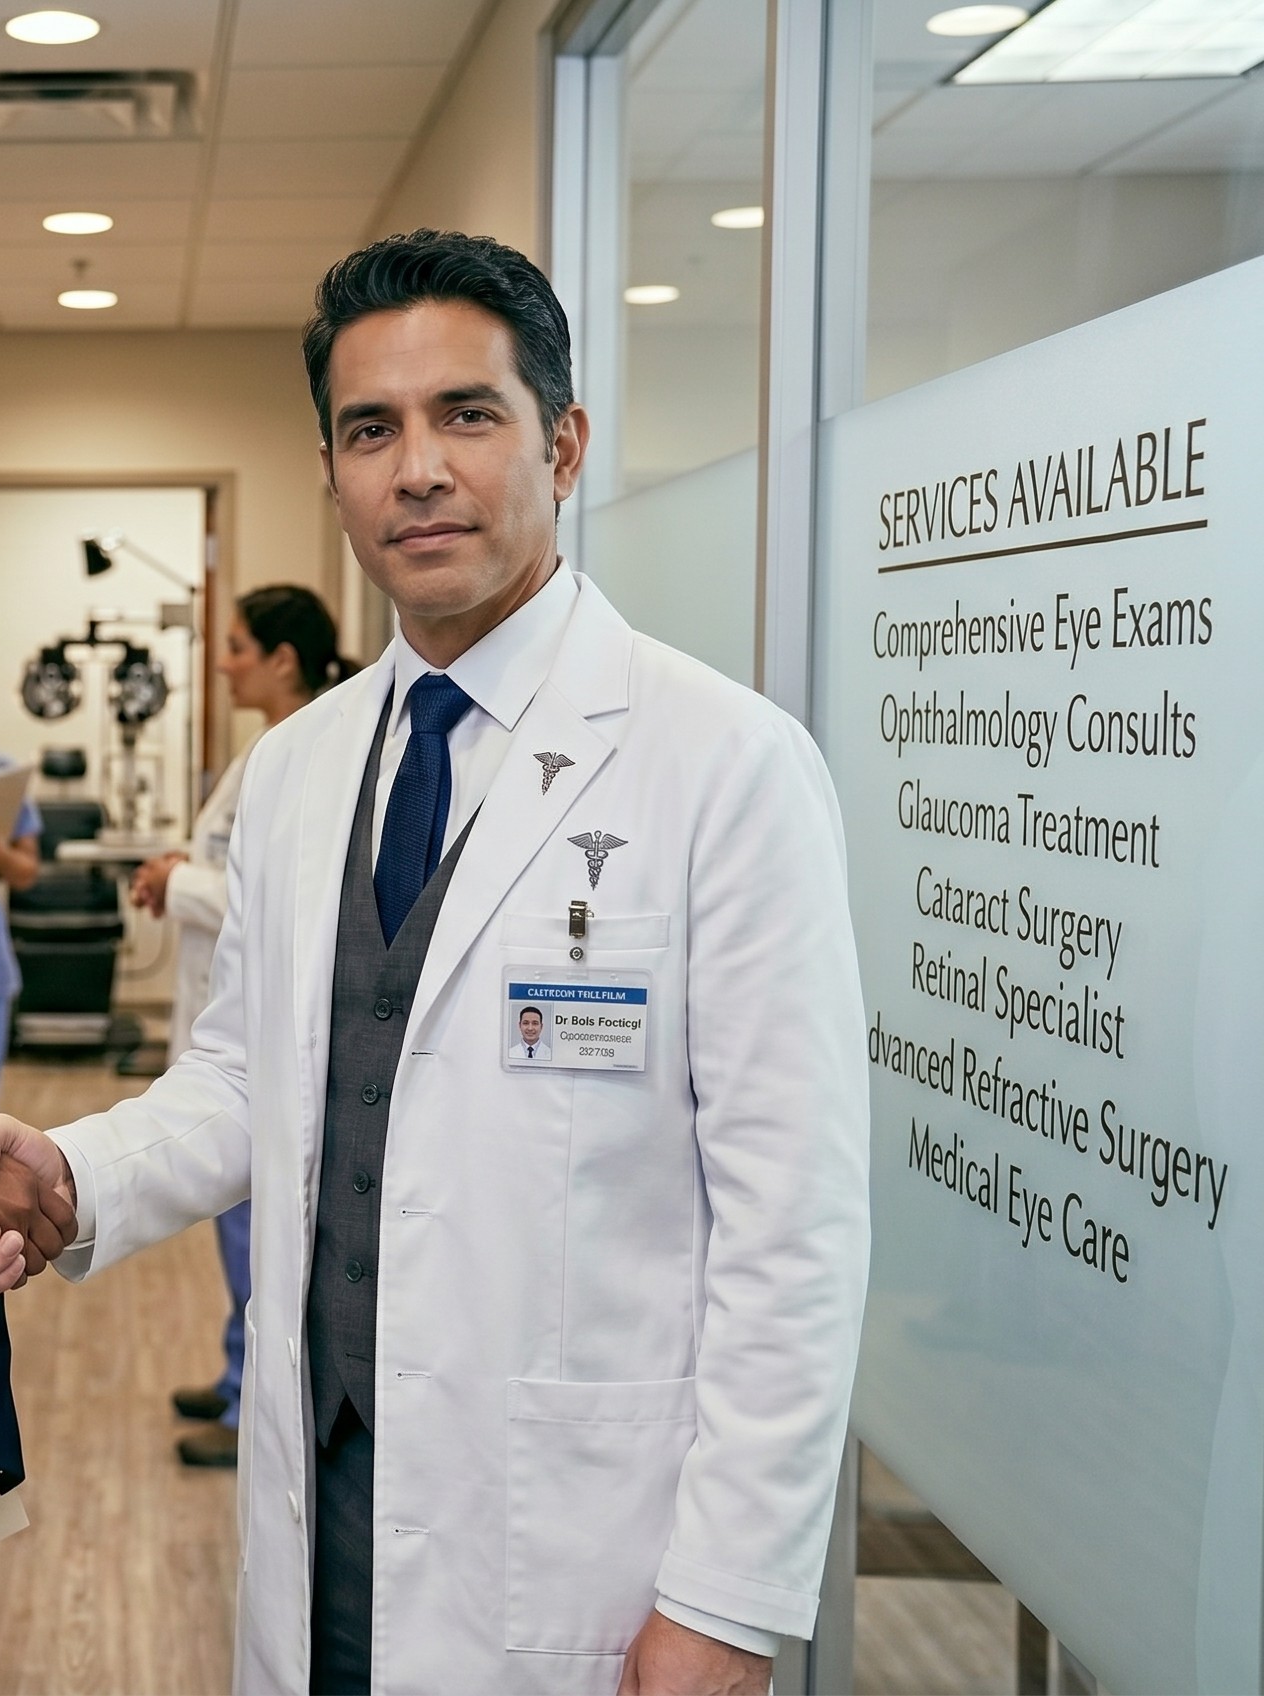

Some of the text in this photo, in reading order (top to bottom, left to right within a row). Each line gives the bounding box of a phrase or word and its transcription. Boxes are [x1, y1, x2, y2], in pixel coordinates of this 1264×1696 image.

[879, 418, 1207, 551] SERVICES AVAILABLE
[873, 587, 1213, 672] Comprehensive Eye Exams
[880, 689, 1197, 768] Ophthalmology Consults
[898, 778, 1161, 868] Glaucoma Treatment
[916, 866, 1122, 981] Cataract Surgery
[555, 1015, 568, 1025] Dr
[912, 941, 1125, 1059] Retinal Specialist
[868, 1011, 1228, 1231] dvanced Refractive Surgery
[909, 1117, 1129, 1284] Medical Eye Care
